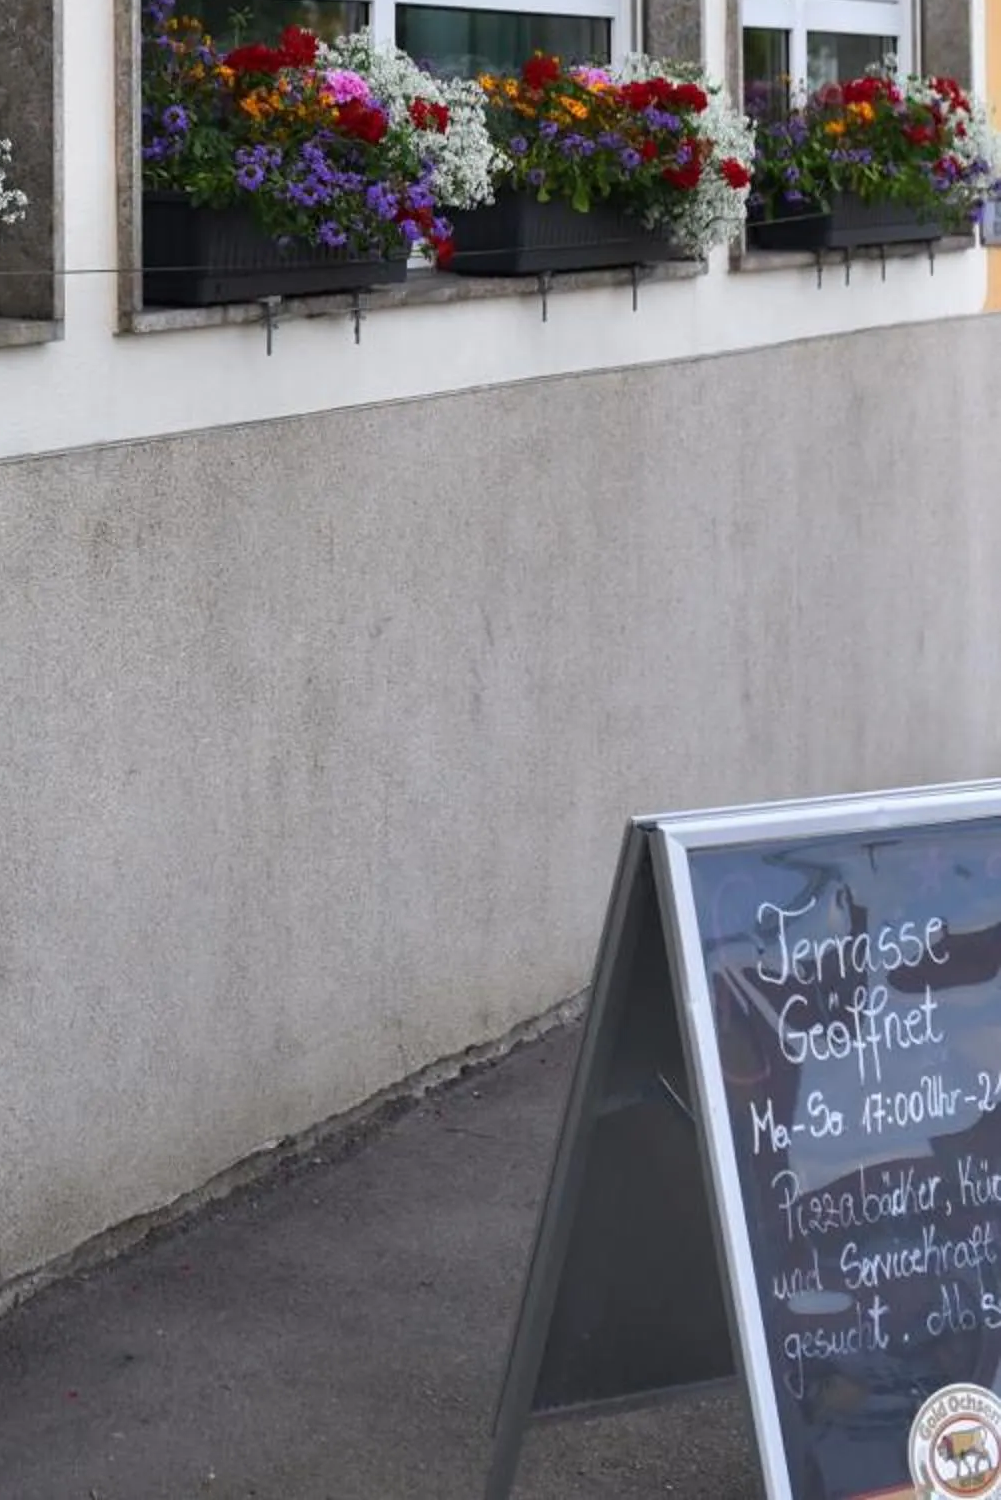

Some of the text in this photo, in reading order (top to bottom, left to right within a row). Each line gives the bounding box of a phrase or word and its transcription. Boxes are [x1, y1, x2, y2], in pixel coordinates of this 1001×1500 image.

[757, 896, 950, 985] Terrasse
[778, 983, 944, 1086] Geöffnet
[773, 1248, 824, 1300] und
